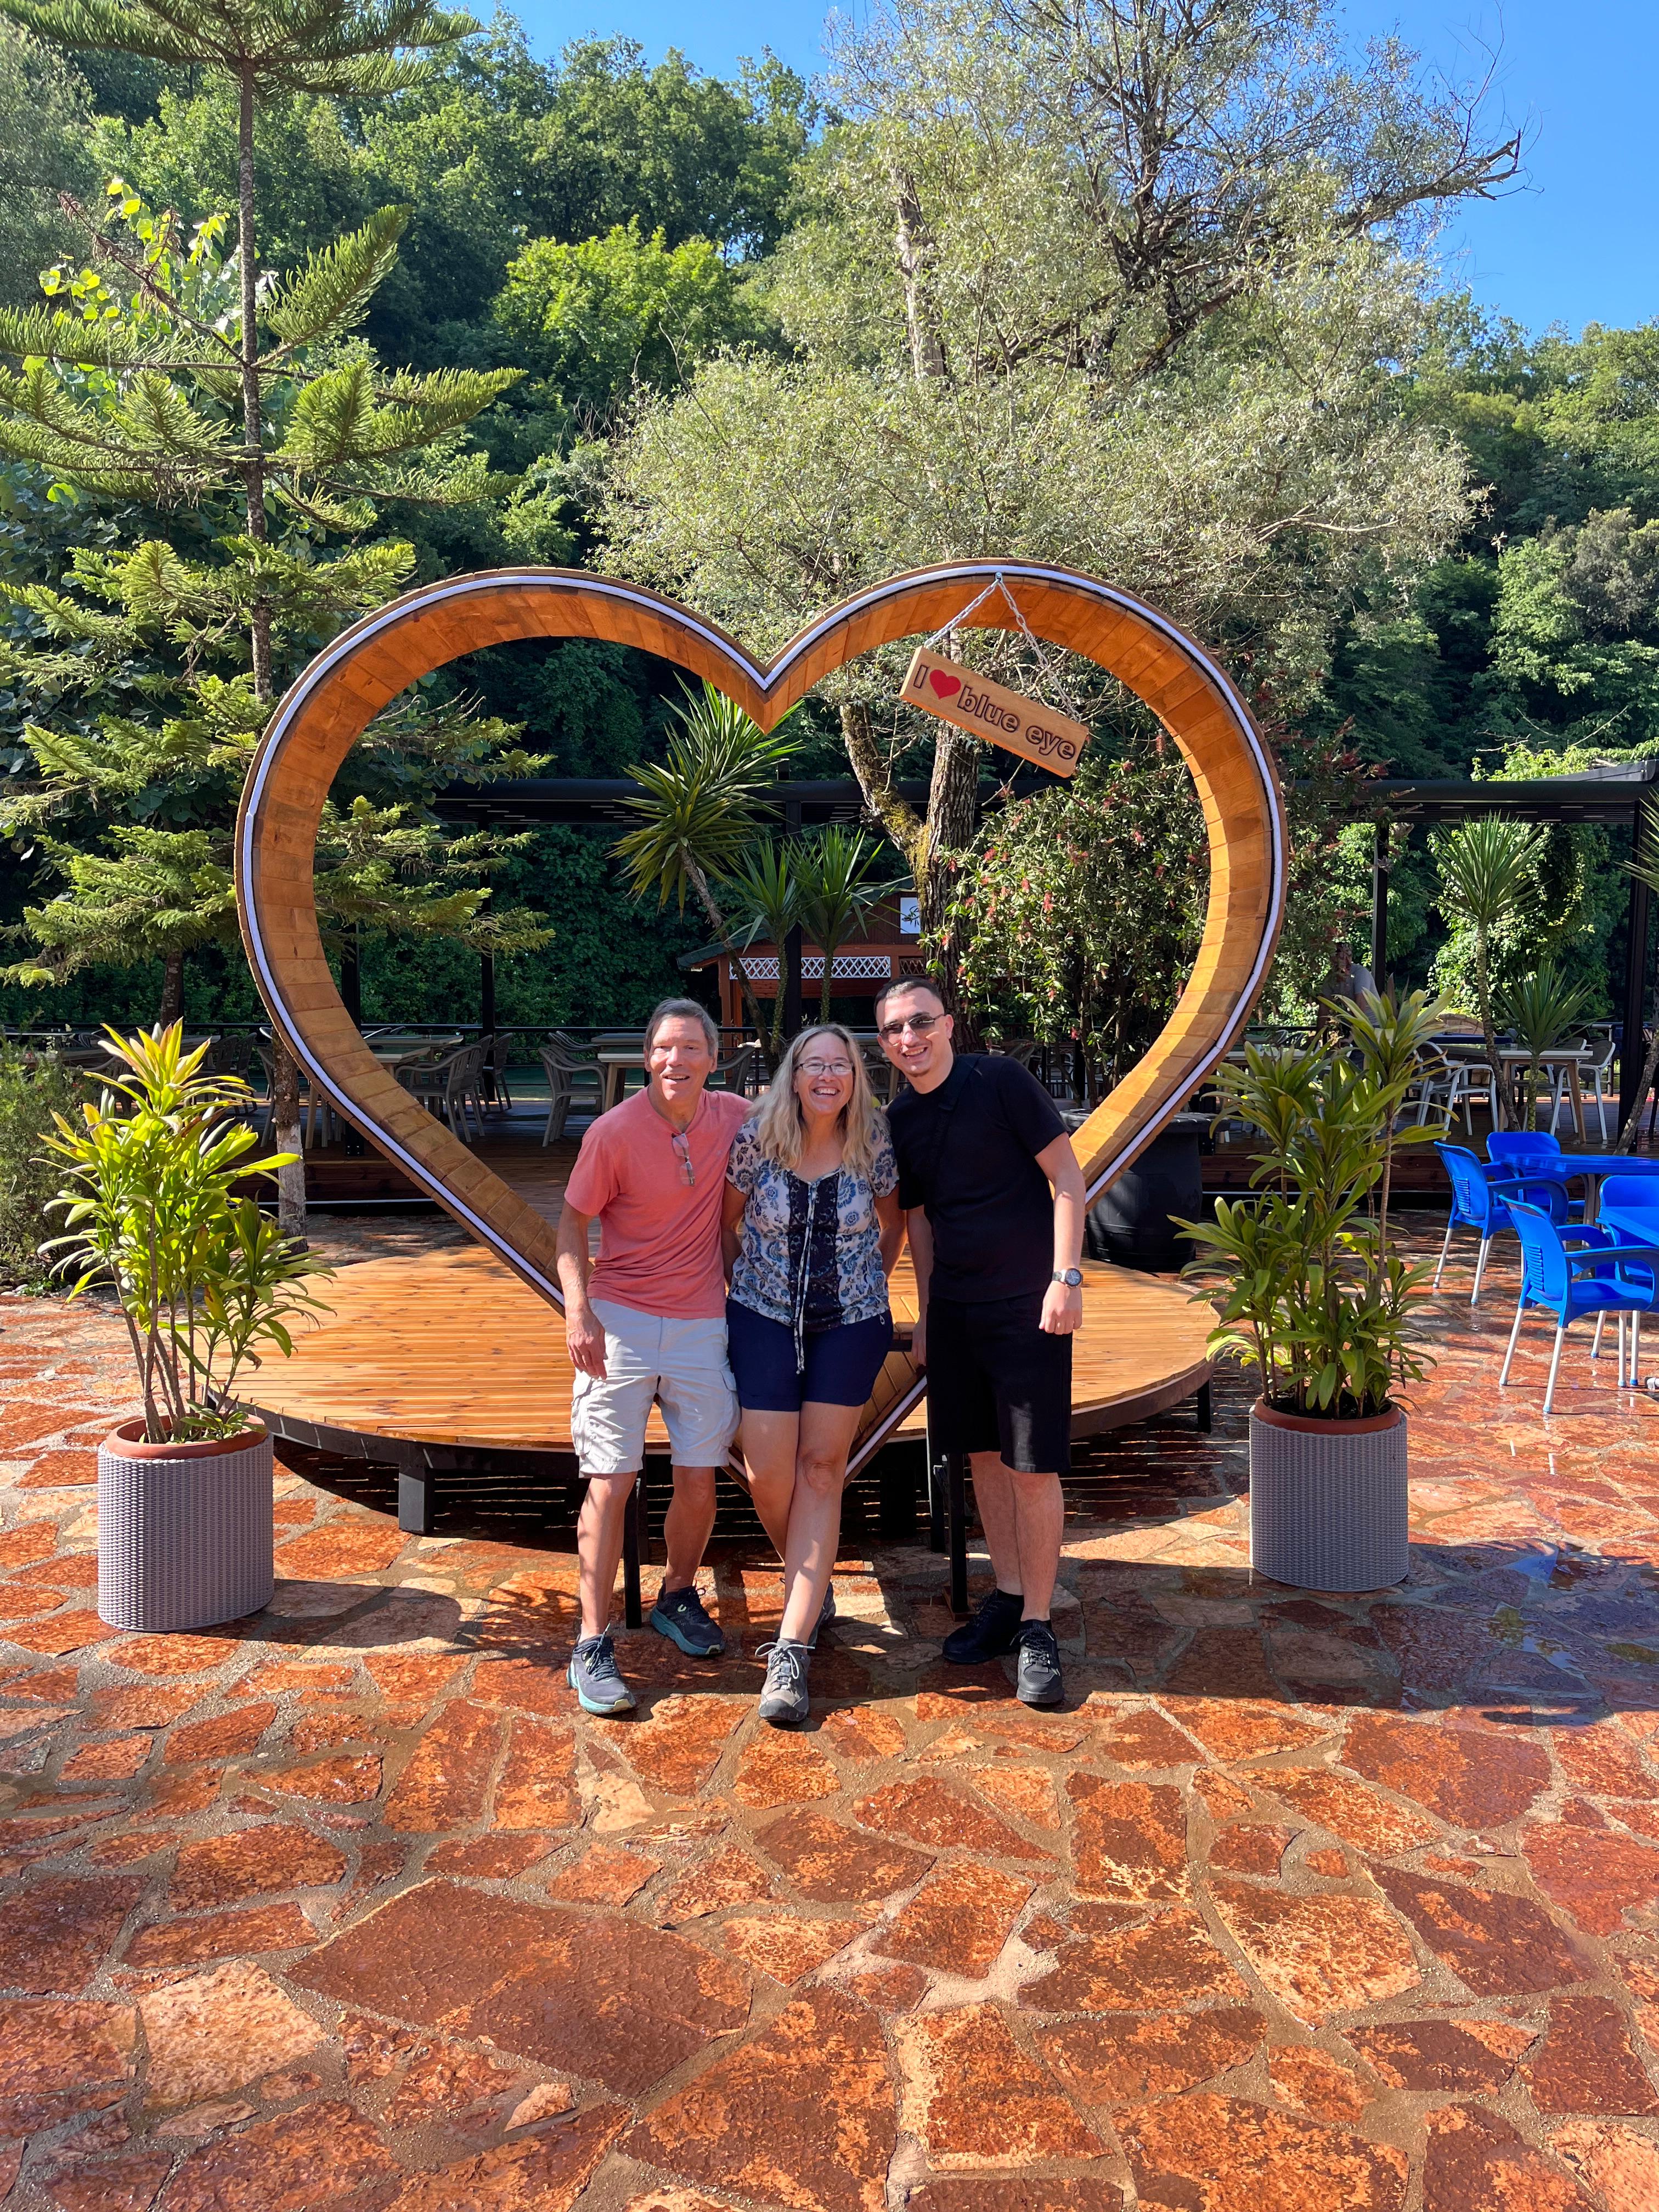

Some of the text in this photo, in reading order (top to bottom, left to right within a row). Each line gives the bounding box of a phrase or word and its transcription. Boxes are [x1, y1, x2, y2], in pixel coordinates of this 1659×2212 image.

[913, 664, 1076, 760] I blue eye
